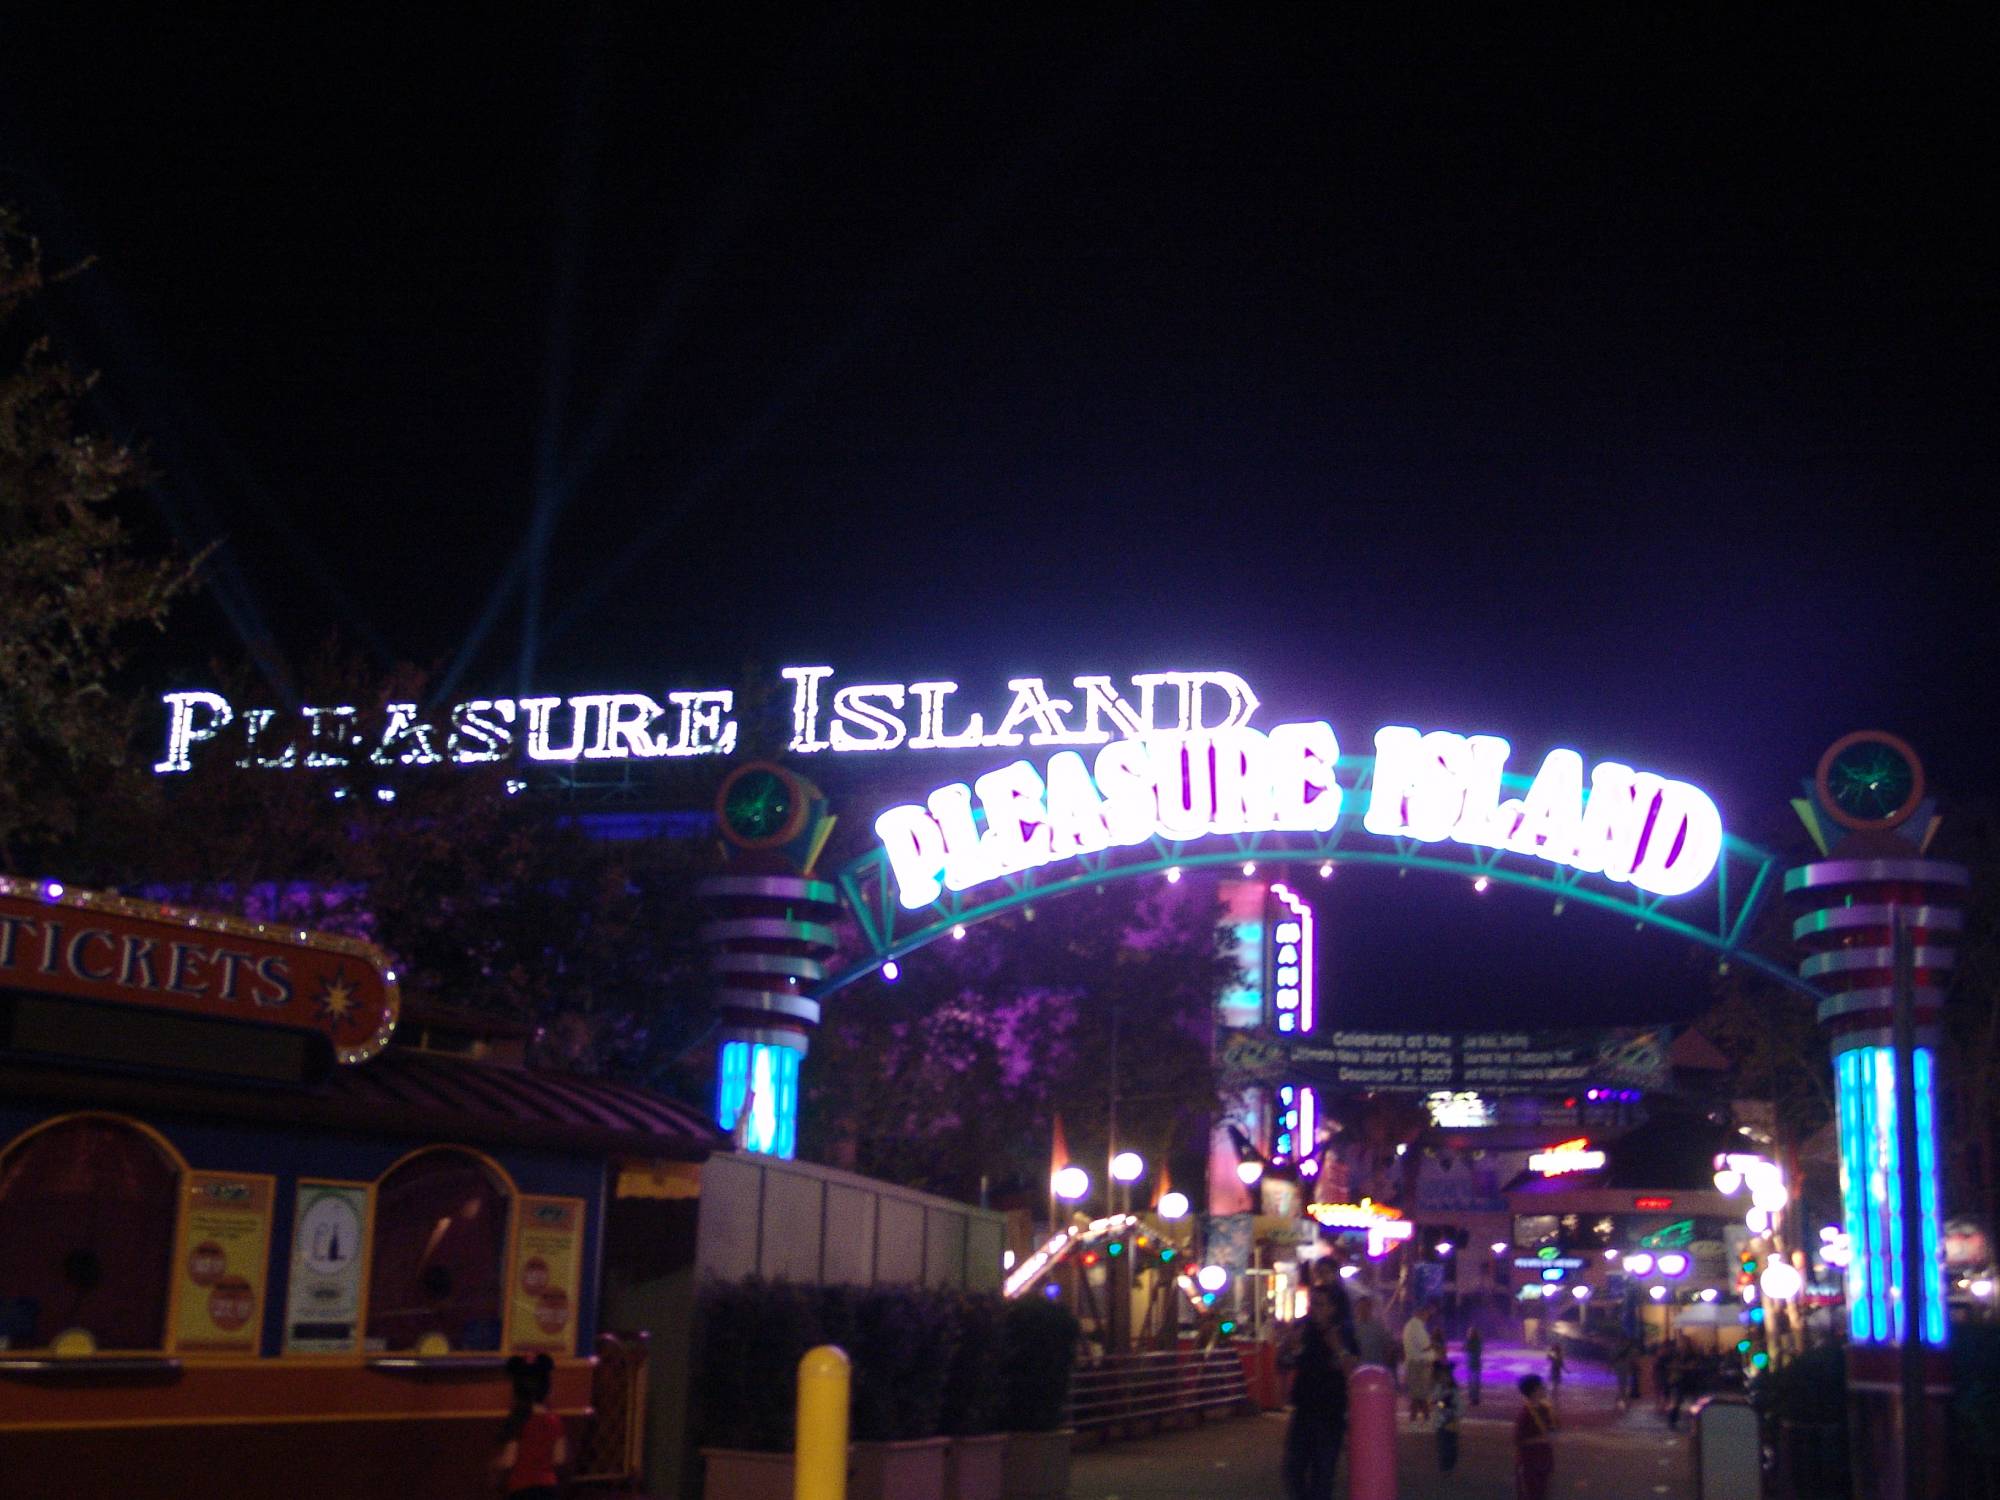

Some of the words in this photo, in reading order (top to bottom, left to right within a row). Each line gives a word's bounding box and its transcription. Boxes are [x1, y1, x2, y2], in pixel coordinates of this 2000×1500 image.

[154, 690, 737, 773] PLEASURE
[782, 666, 1261, 752] ISLAND
[875, 720, 1342, 910] PLEASURE
[1363, 725, 1723, 897] ISLAND
[0, 915, 293, 1007] TICKETS
